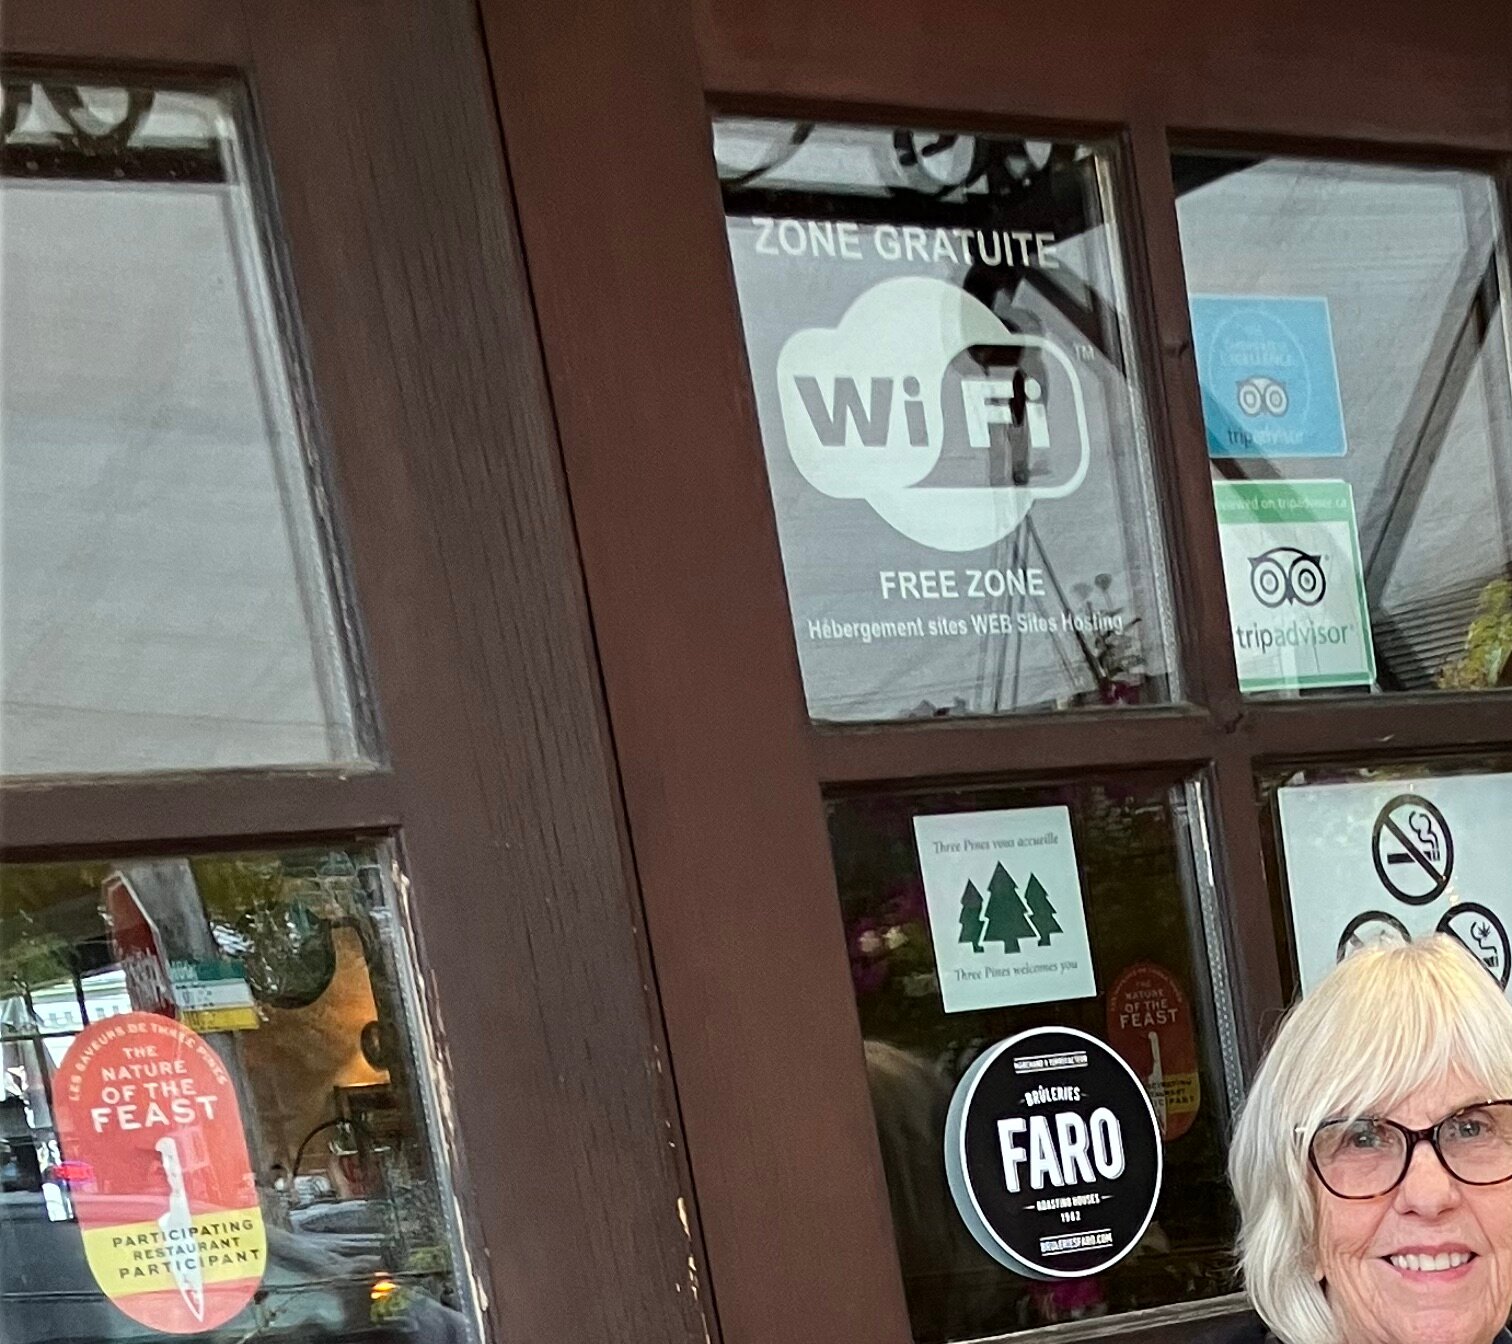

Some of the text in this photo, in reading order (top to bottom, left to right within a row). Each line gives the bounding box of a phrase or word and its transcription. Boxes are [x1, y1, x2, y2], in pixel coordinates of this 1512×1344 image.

[752, 218, 1059, 269] ZONE GRATUITE
[880, 568, 1046, 600] FREE ZONE
[808, 611, 1124, 643] Hébergement sites WEB Sites Hosting
[1236, 620, 1349, 654] tripadvisor
[964, 838, 990, 852] Pines
[985, 965, 1010, 979] Pines
[1060, 960, 1078, 976] you
[1119, 1008, 1179, 1029] FEAST
[1125, 999, 1168, 1014] OF THE
[122, 1045, 159, 1059] THE
[101, 1060, 187, 1082] NATURE
[101, 1078, 197, 1105] OF THE
[1024, 1084, 1081, 1107] BRÛLERIES
[90, 1095, 218, 1133] FEAST
[997, 1107, 1126, 1193] FARO
[112, 1219, 254, 1248] PARTICIPATING
[133, 1236, 241, 1261] RESTAURANT
[119, 1248, 260, 1279] PARTICIPANT
